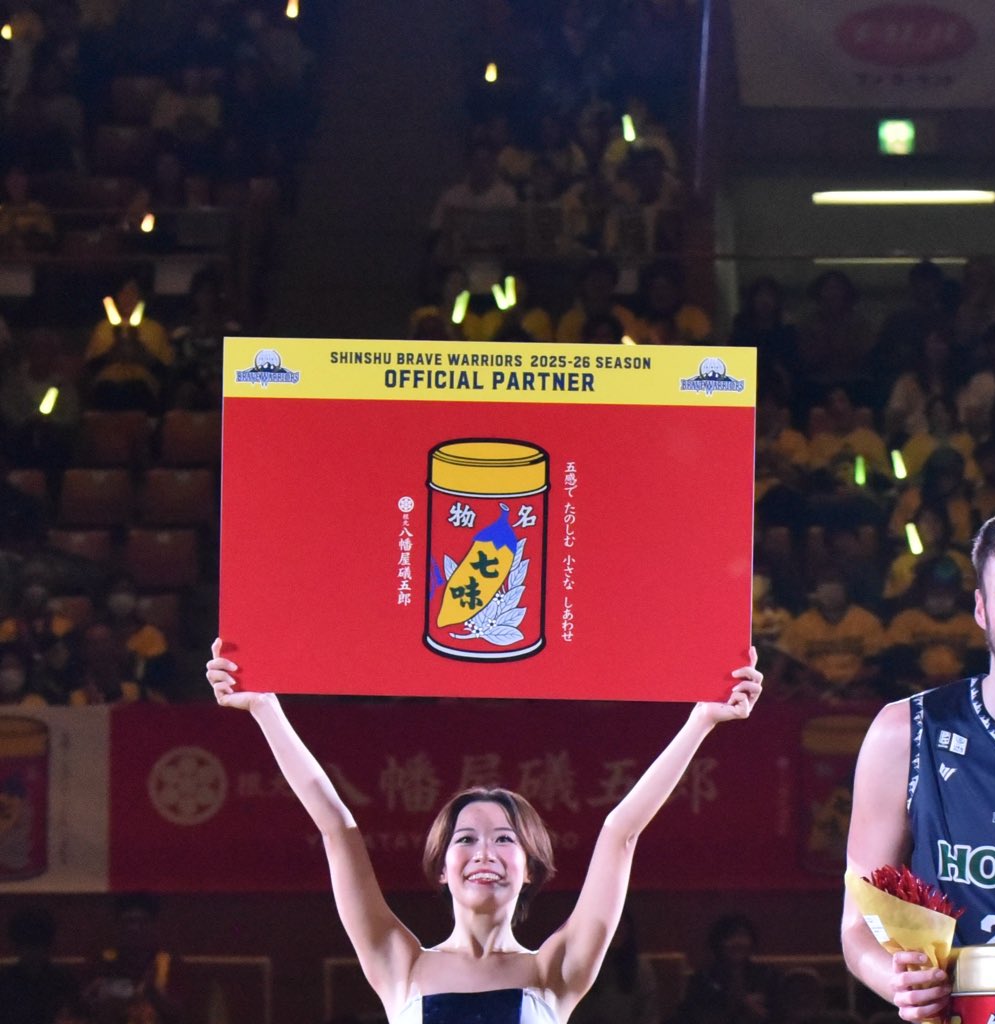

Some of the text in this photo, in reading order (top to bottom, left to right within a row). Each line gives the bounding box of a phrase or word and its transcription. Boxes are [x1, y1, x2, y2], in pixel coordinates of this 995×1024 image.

[330, 351, 652, 370] SHINSHU BRAVE WARRIORS 2025-26 SEASON
[384, 368, 596, 392] OFFICIAL PARTNER
[561, 461, 577, 642] 五感で たのしむ 小さな しあわせ
